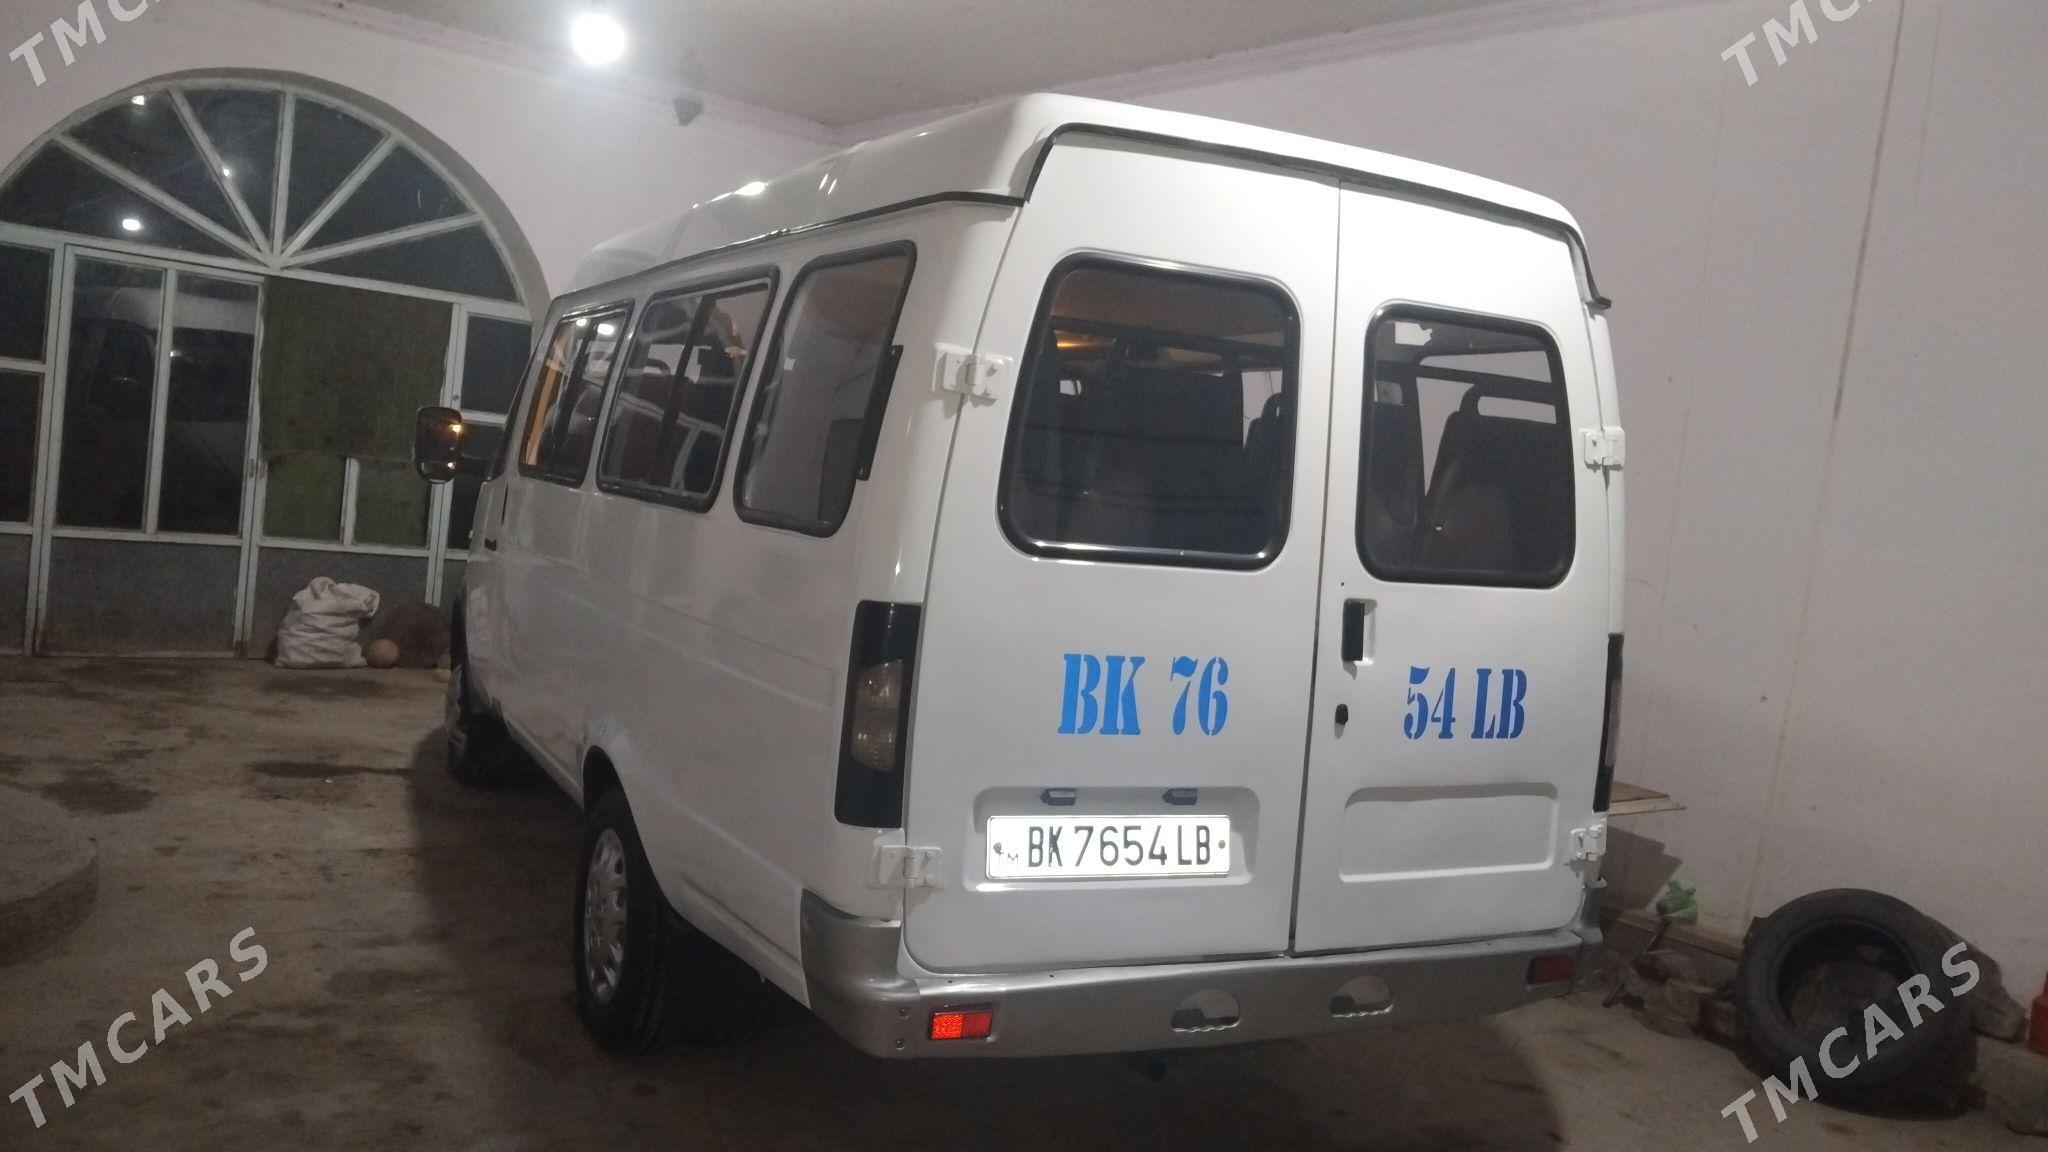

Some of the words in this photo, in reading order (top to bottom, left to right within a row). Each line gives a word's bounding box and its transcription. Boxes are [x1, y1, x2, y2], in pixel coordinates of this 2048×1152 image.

[1057, 652, 1145, 736] BK
[1170, 655, 1230, 737] 76
[1403, 666, 1456, 740] 54
[1471, 668, 1528, 740] LB
